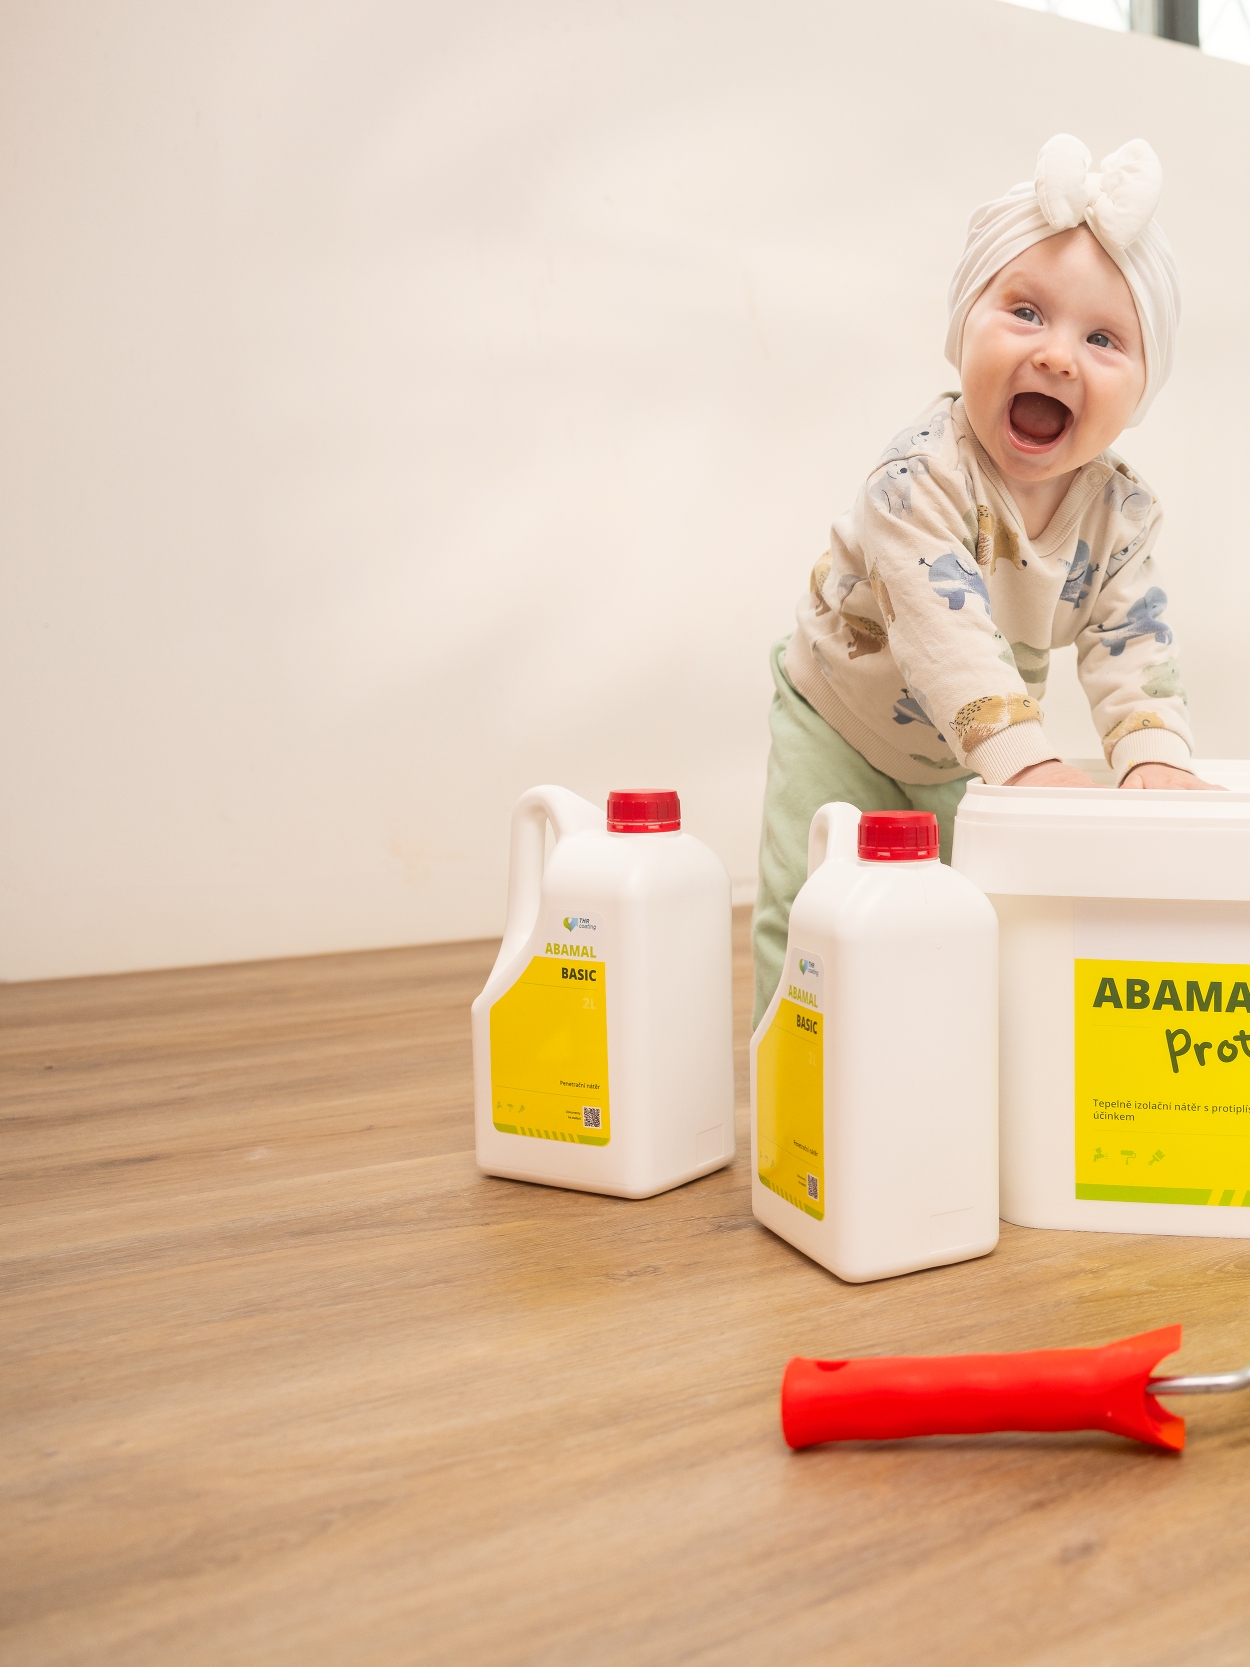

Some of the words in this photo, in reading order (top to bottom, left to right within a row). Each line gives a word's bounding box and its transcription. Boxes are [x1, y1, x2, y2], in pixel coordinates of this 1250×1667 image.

[545, 942, 597, 959] ABAMAL
[561, 967, 597, 982] BASIC
[583, 997, 597, 1010] 2L
[788, 984, 818, 1009] ABAMAL
[796, 1014, 818, 1035] BASIC
[1092, 1098, 1132, 1110] Tepelně
[1134, 1100, 1172, 1111] izolační
[1174, 1102, 1201, 1112] nátěr
[1203, 1104, 1209, 1112] s
[1093, 1111, 1135, 1121] účinkem
